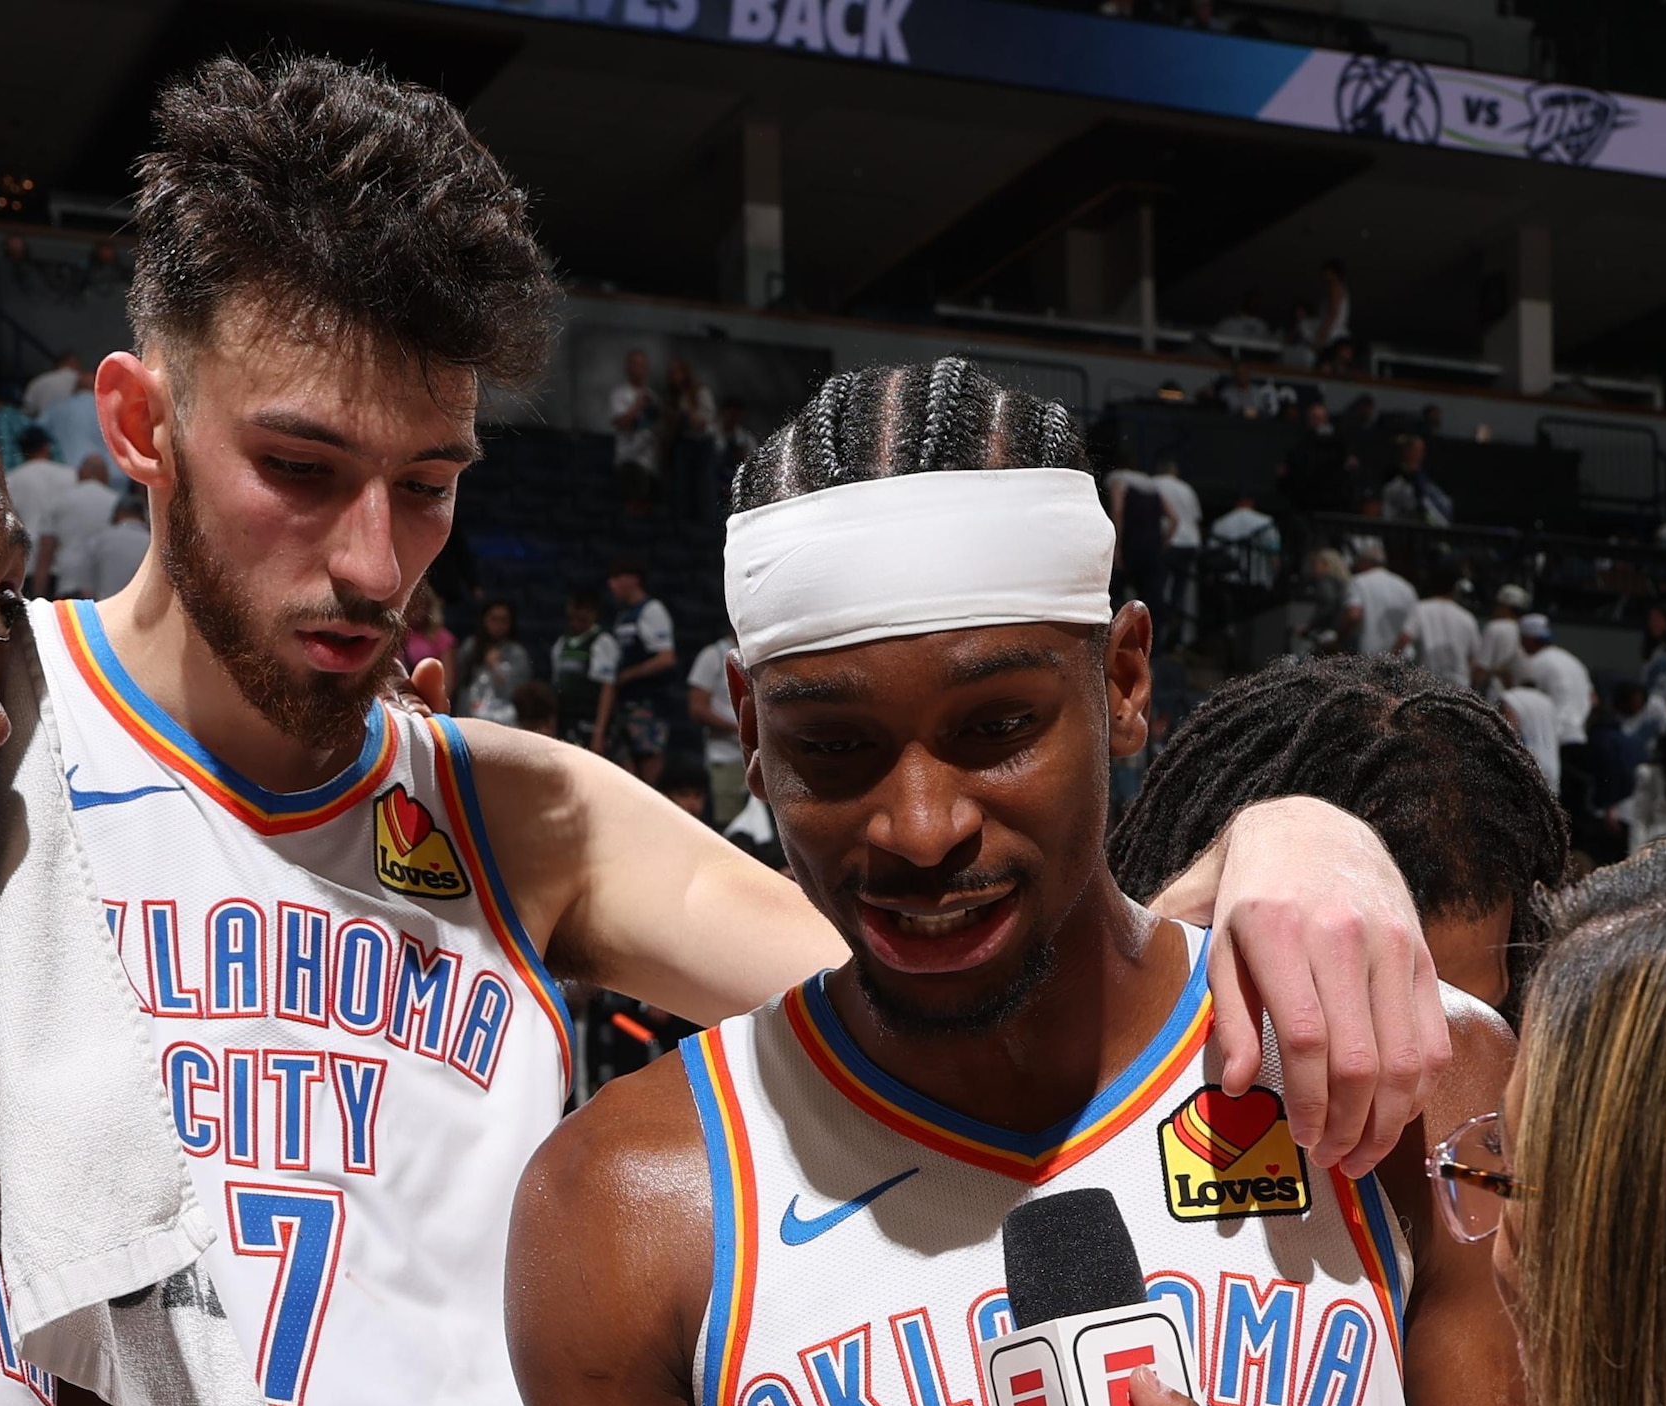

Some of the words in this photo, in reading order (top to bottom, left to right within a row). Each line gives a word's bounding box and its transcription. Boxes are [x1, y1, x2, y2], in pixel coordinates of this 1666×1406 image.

[727, 0, 911, 63] BACK
[103, 897, 514, 1092] LAHOMA
[163, 1040, 388, 1176] CITY
